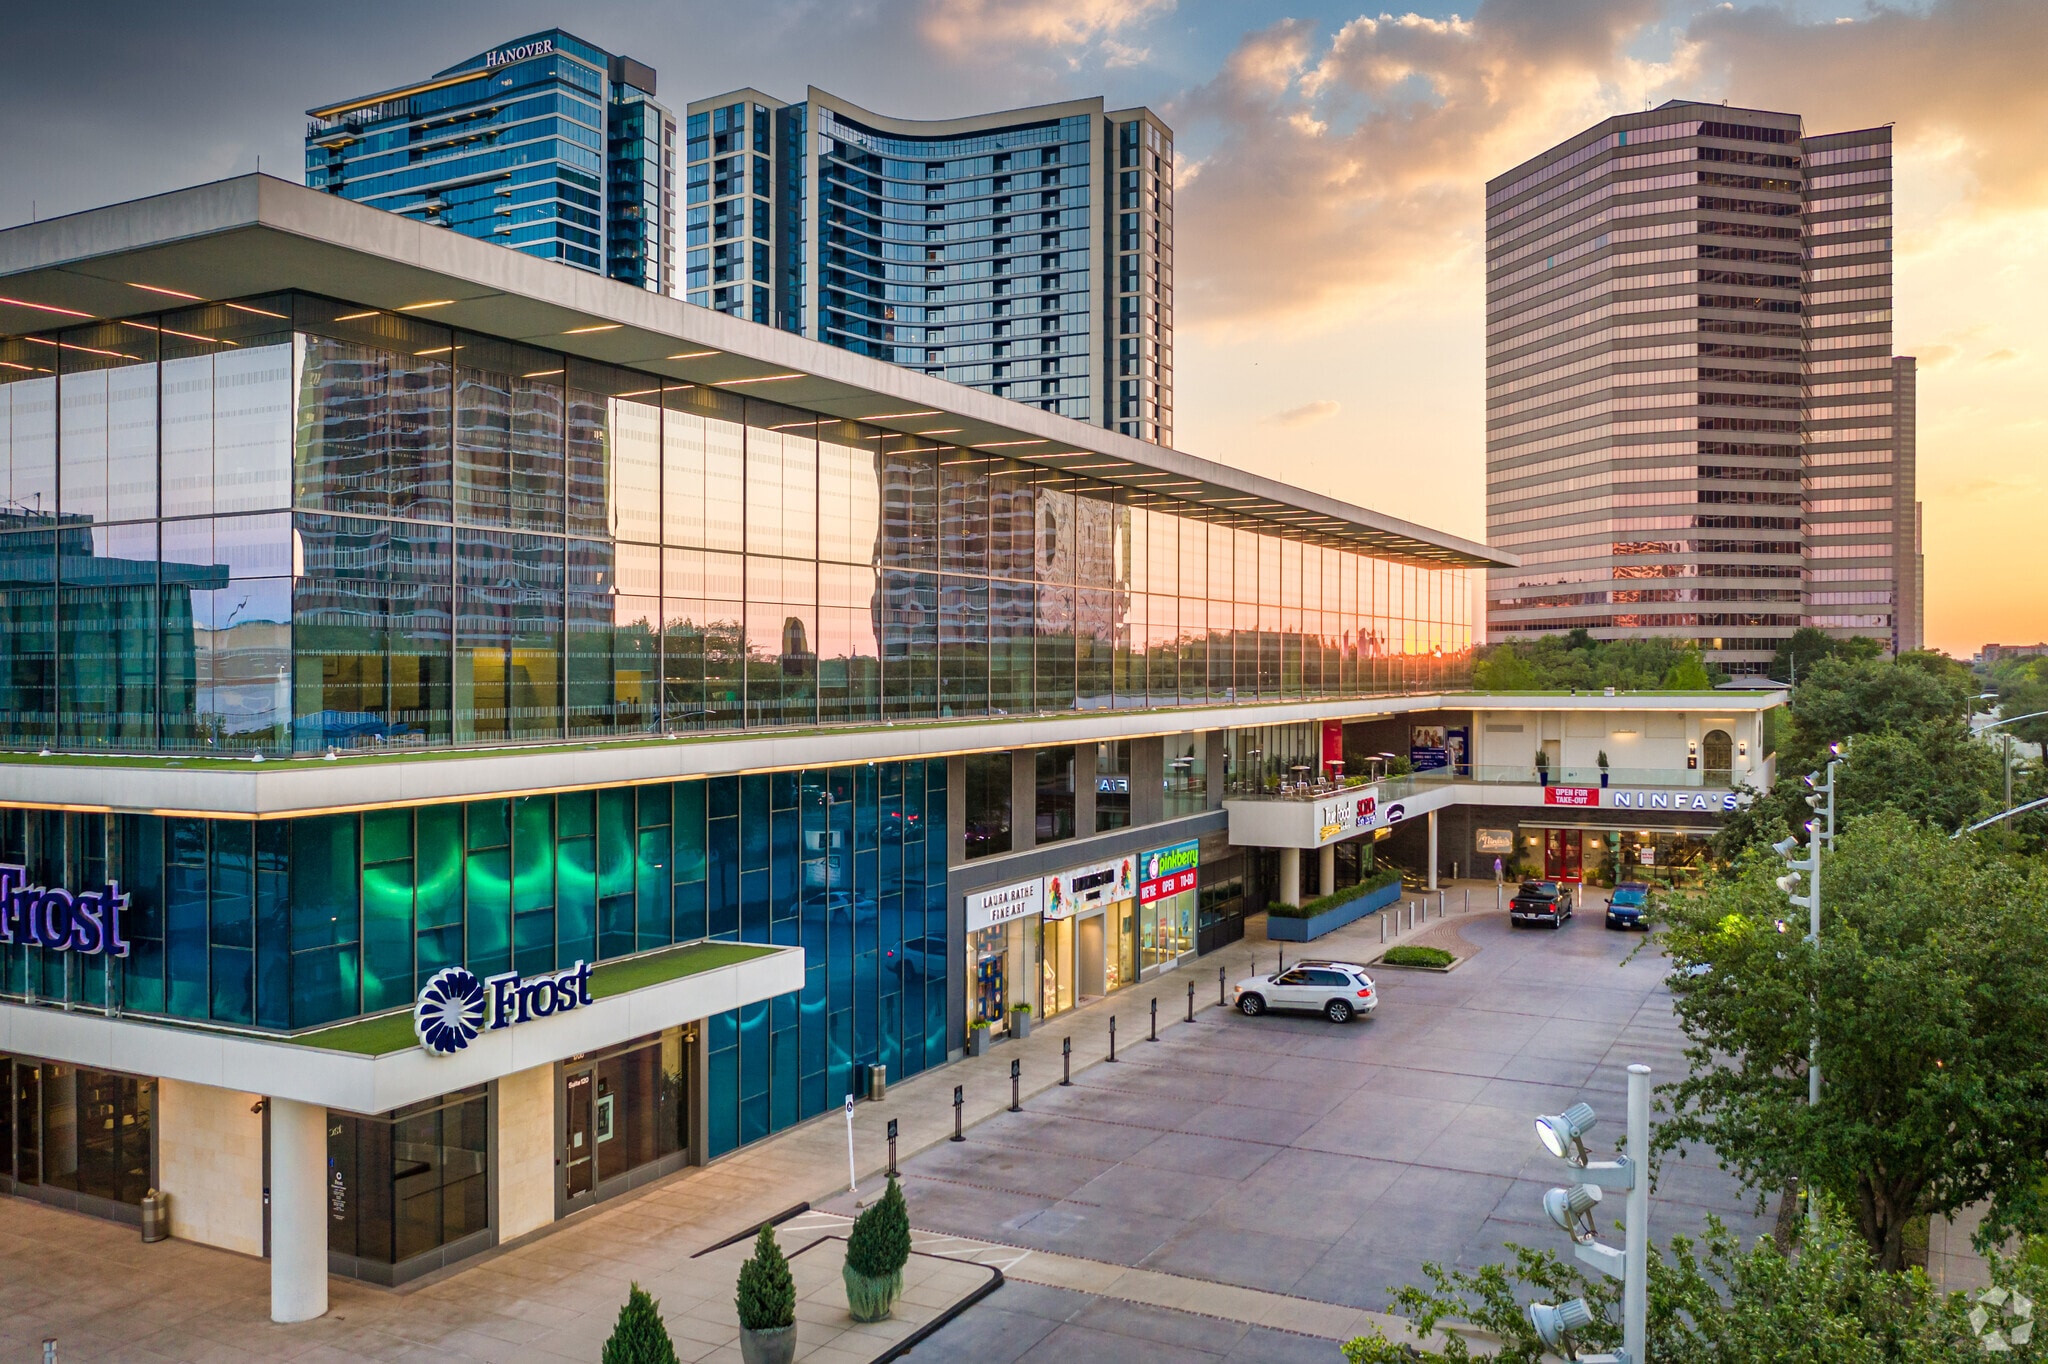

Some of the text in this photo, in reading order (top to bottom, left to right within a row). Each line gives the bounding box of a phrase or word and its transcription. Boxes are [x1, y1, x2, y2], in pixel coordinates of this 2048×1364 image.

[486, 40, 553, 67] HANOVER
[1555, 788, 1573, 796] OPEN
[1555, 796, 1588, 804] TAKE-OUT
[1614, 792, 1737, 810] NINFA'S
[1335, 801, 1351, 823] Food
[1159, 849, 1199, 877] pinkberry
[982, 886, 1034, 908] LAURA RATHE
[1141, 872, 1194, 900] WE'RE OPEN TO-GO
[990, 902, 1025, 921] FINE ART
[484, 959, 594, 1033] Frost
